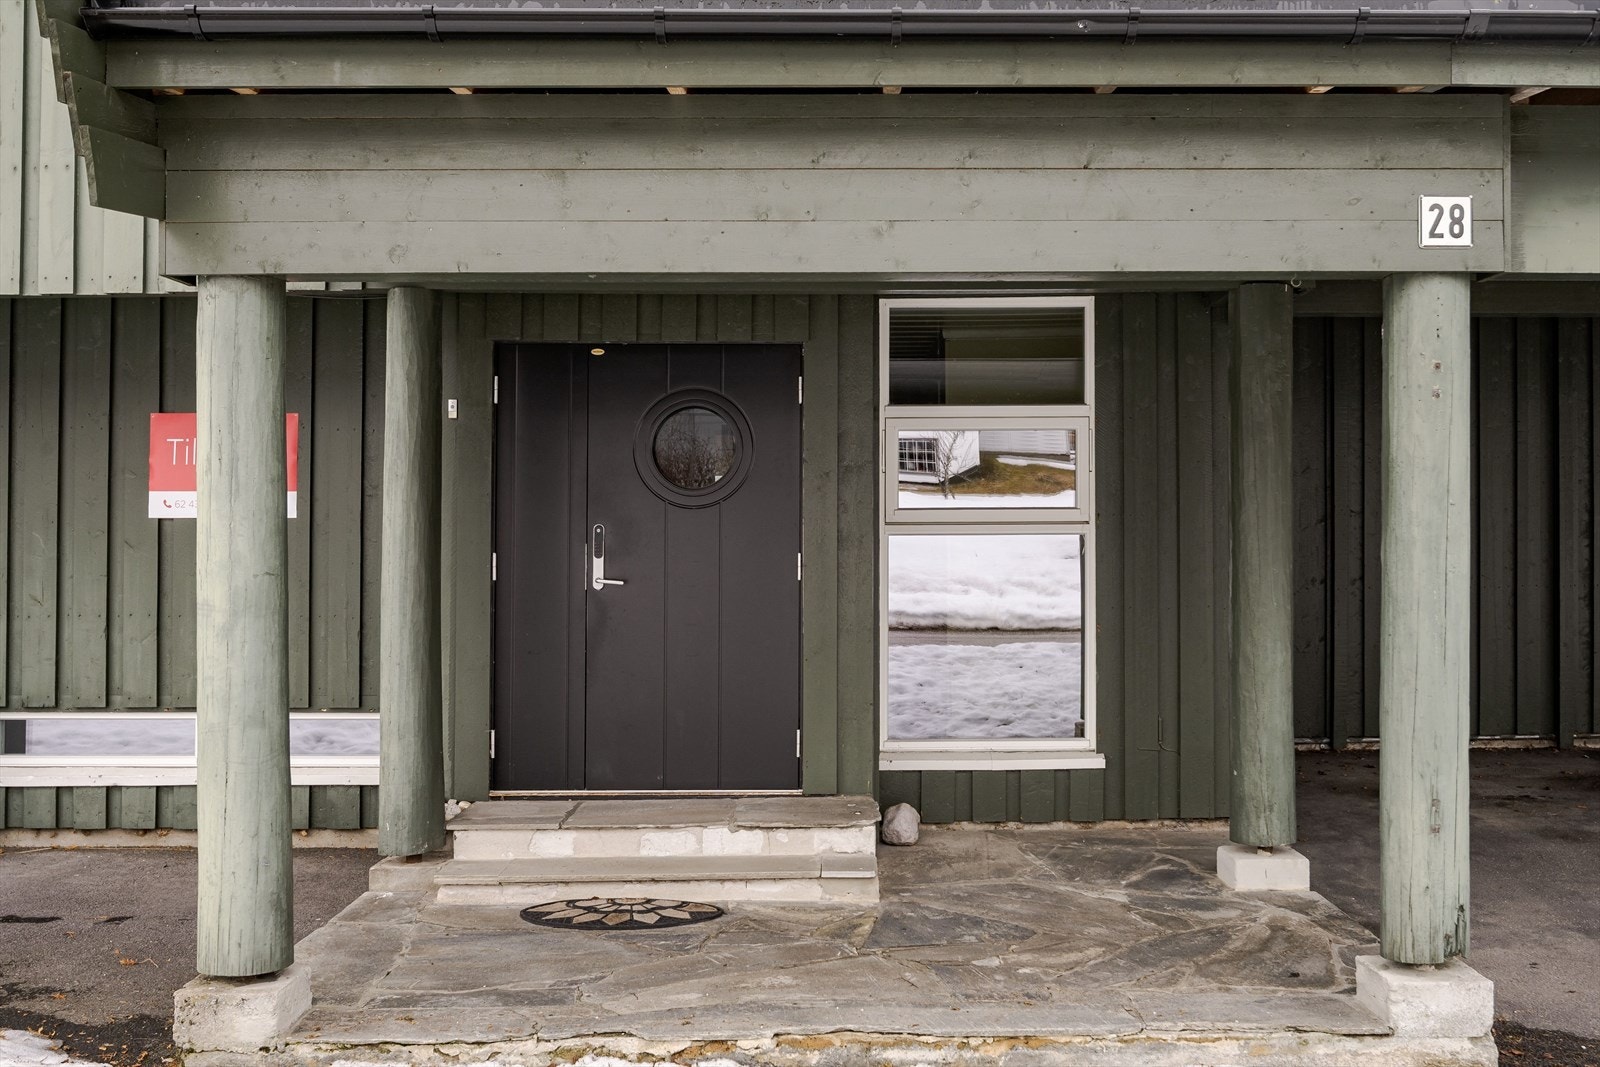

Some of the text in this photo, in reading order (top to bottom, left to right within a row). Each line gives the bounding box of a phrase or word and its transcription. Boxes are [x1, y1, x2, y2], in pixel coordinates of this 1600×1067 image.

[1428, 203, 1465, 239] 28
[166, 437, 197, 466] Til
[174, 499, 186, 509] 62
